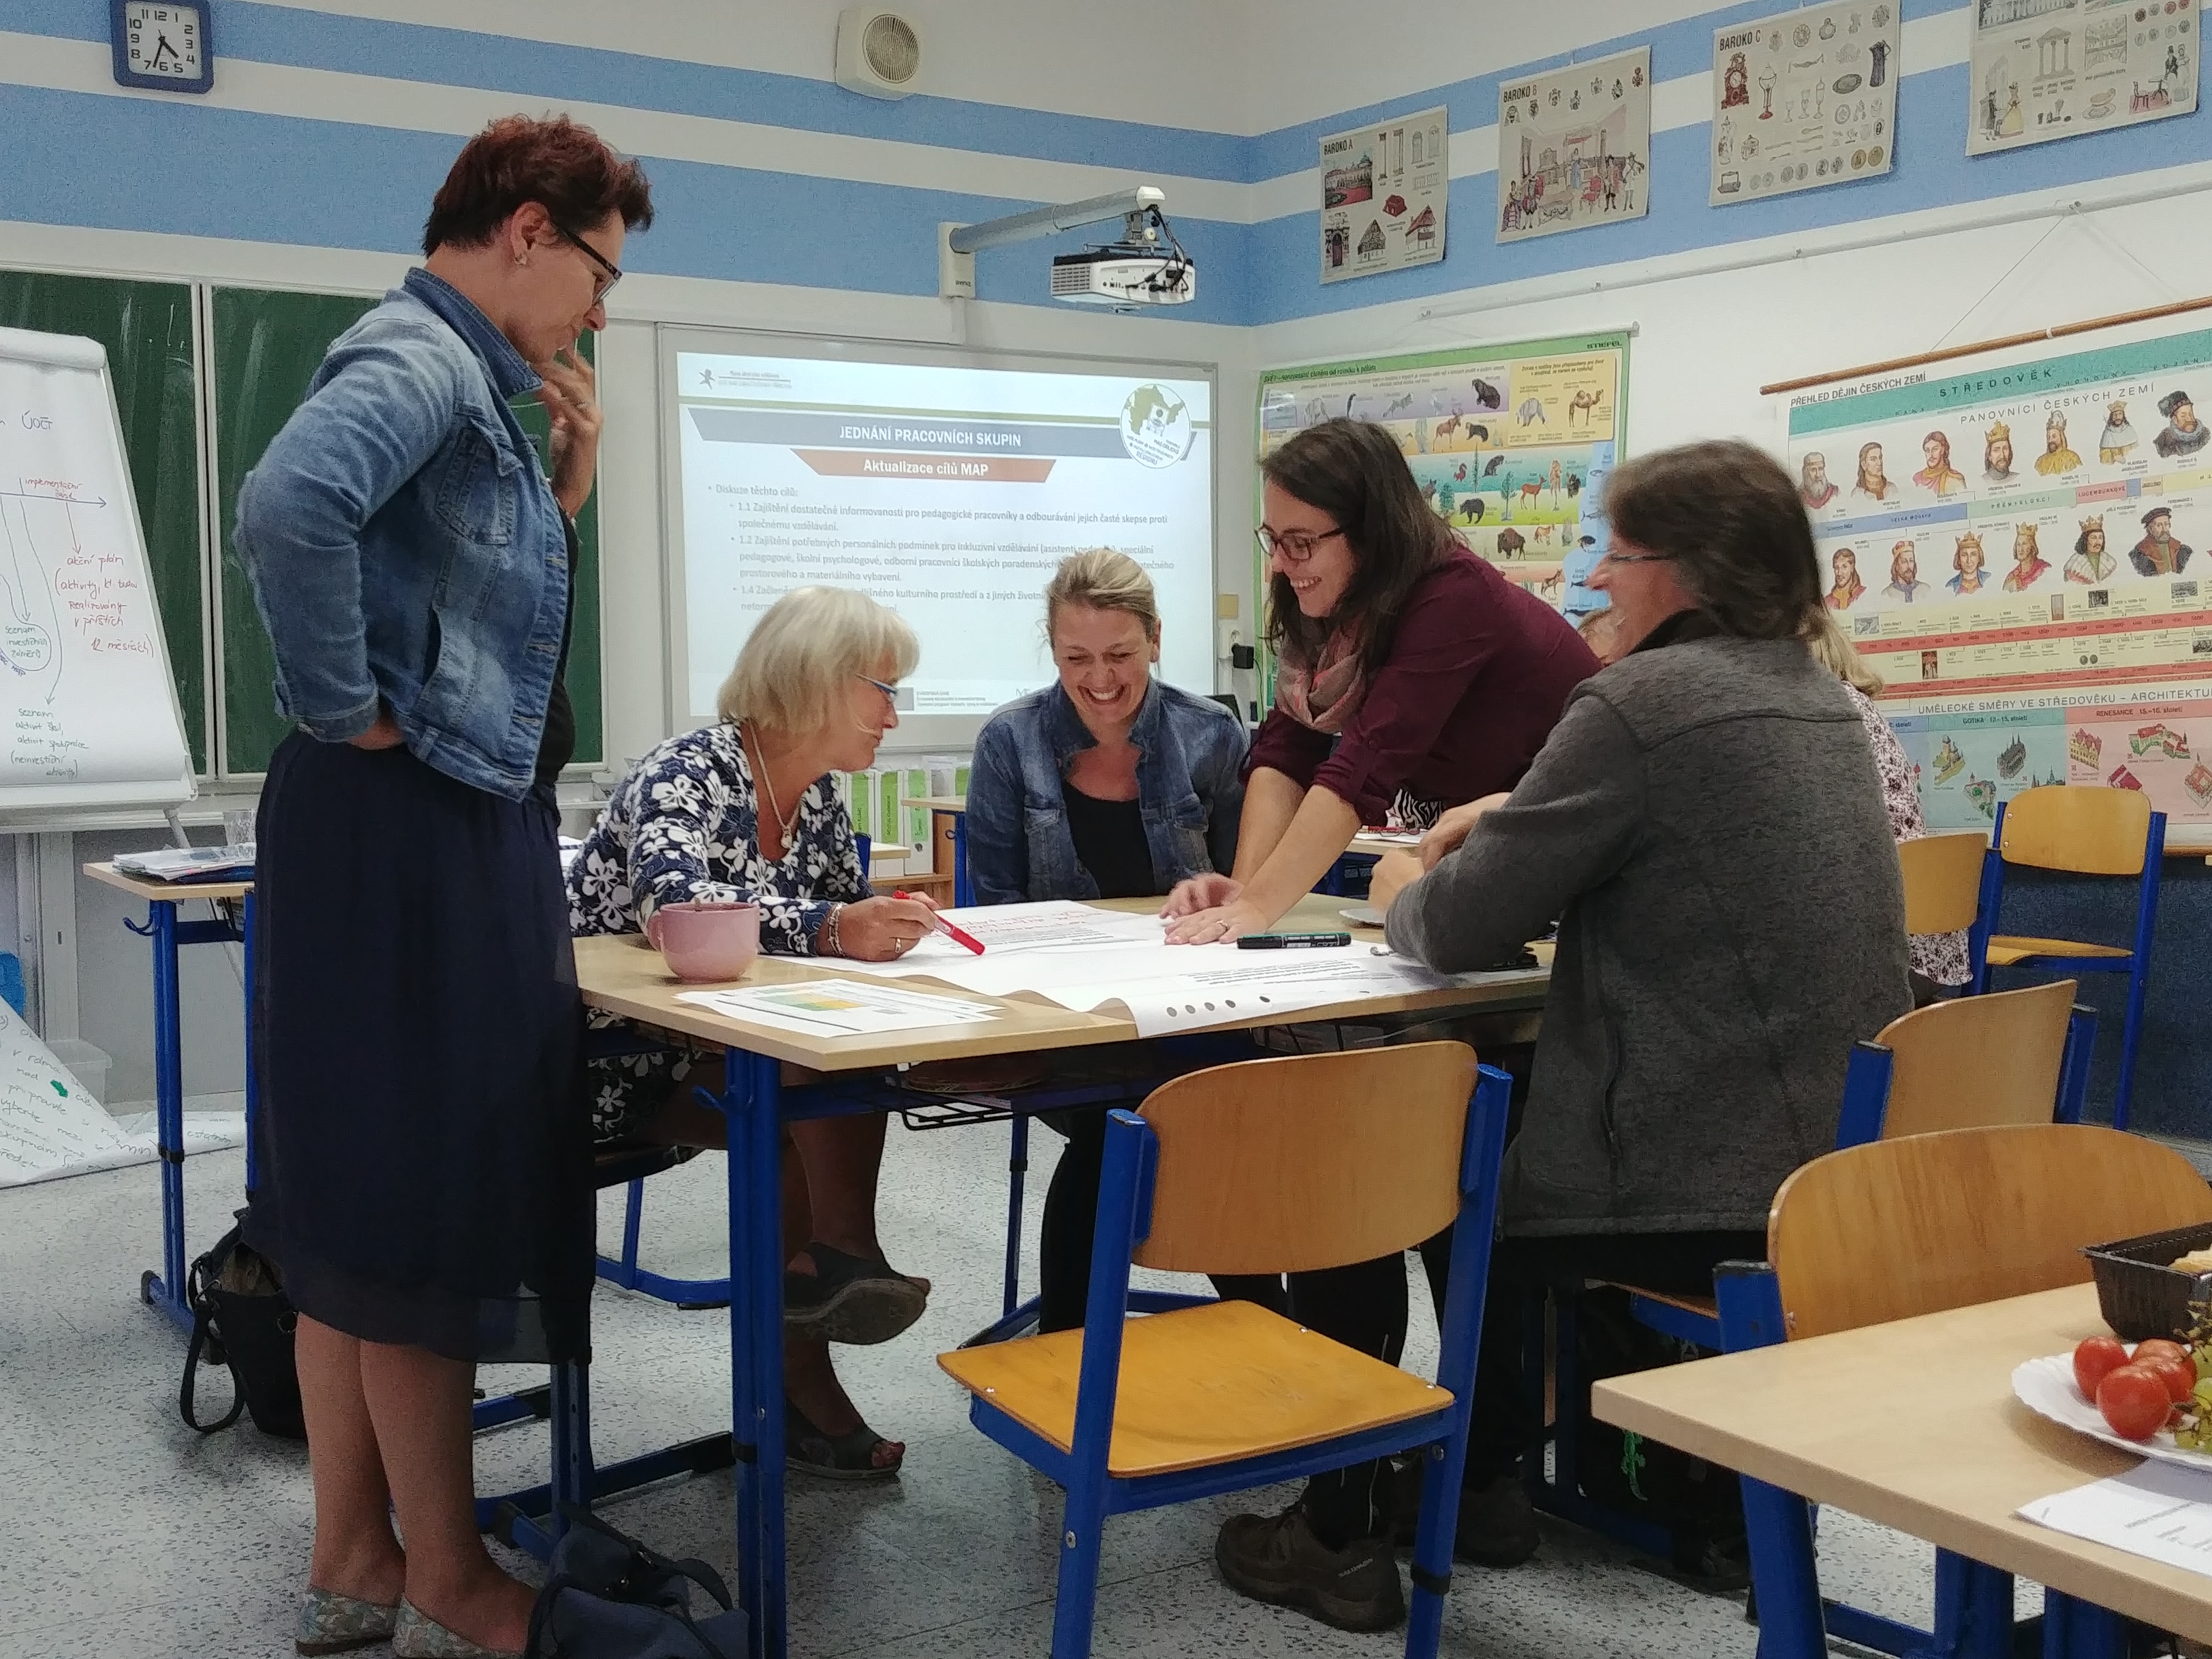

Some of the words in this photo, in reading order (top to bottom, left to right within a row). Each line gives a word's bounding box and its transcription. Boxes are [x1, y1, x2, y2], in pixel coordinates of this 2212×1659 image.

[141, 9, 149, 19] 11
[154, 11, 167, 21] 12
[175, 12, 178, 22] 1
[129, 18, 142, 29] 10
[184, 24, 193, 35] 2
[131, 34, 139, 43] 9
[185, 39, 193, 49] 3
[1719, 31, 1753, 51] BAROKO
[1756, 30, 1761, 43] C
[131, 49, 140, 58] 8
[186, 55, 195, 64] 4
[144, 60, 152, 70] 7
[160, 62, 168, 71] 6
[174, 63, 183, 73] 5
[1503, 87, 1530, 103] BAROKO
[1532, 84, 1537, 96] B
[1324, 140, 1347, 155] BAROKO
[1348, 139, 1353, 149] A
[1790, 392, 1829, 407] PŘEHLED
[1832, 387, 1857, 399] DĚJIN
[1859, 378, 1901, 393] ČESKÝCH
[1904, 371, 1926, 385] ZEMÍ
[1939, 368, 2052, 397] STŘEDOVĚK
[1960, 404, 2036, 424] PANOVNÍCI
[2044, 391, 2111, 410] ČESKÝCH
[2119, 382, 2155, 398] ZEMÍ
[839, 424, 891, 441] JEDNÁNÍ
[894, 429, 973, 445] PRACOVNÍCH
[976, 432, 1021, 447] SKUPIN
[864, 458, 934, 474] Aktualizace
[936, 460, 957, 475] cílů
[960, 462, 988, 476] MAP
[751, 485, 778, 496] těchto
[905, 509, 919, 518] pro
[974, 510, 1018, 522] pracovníky
[1121, 515, 1147, 525] skepse
[942, 543, 956, 551] pro
[1918, 700, 1975, 714] UMĚLECKÉ
[1979, 699, 2016, 711] SMĚRY
[2020, 699, 2034, 708] VE
[2039, 693, 2116, 707] STŘEDOVĚKU
[2131, 688, 2212, 701] ARCHITEKTU
